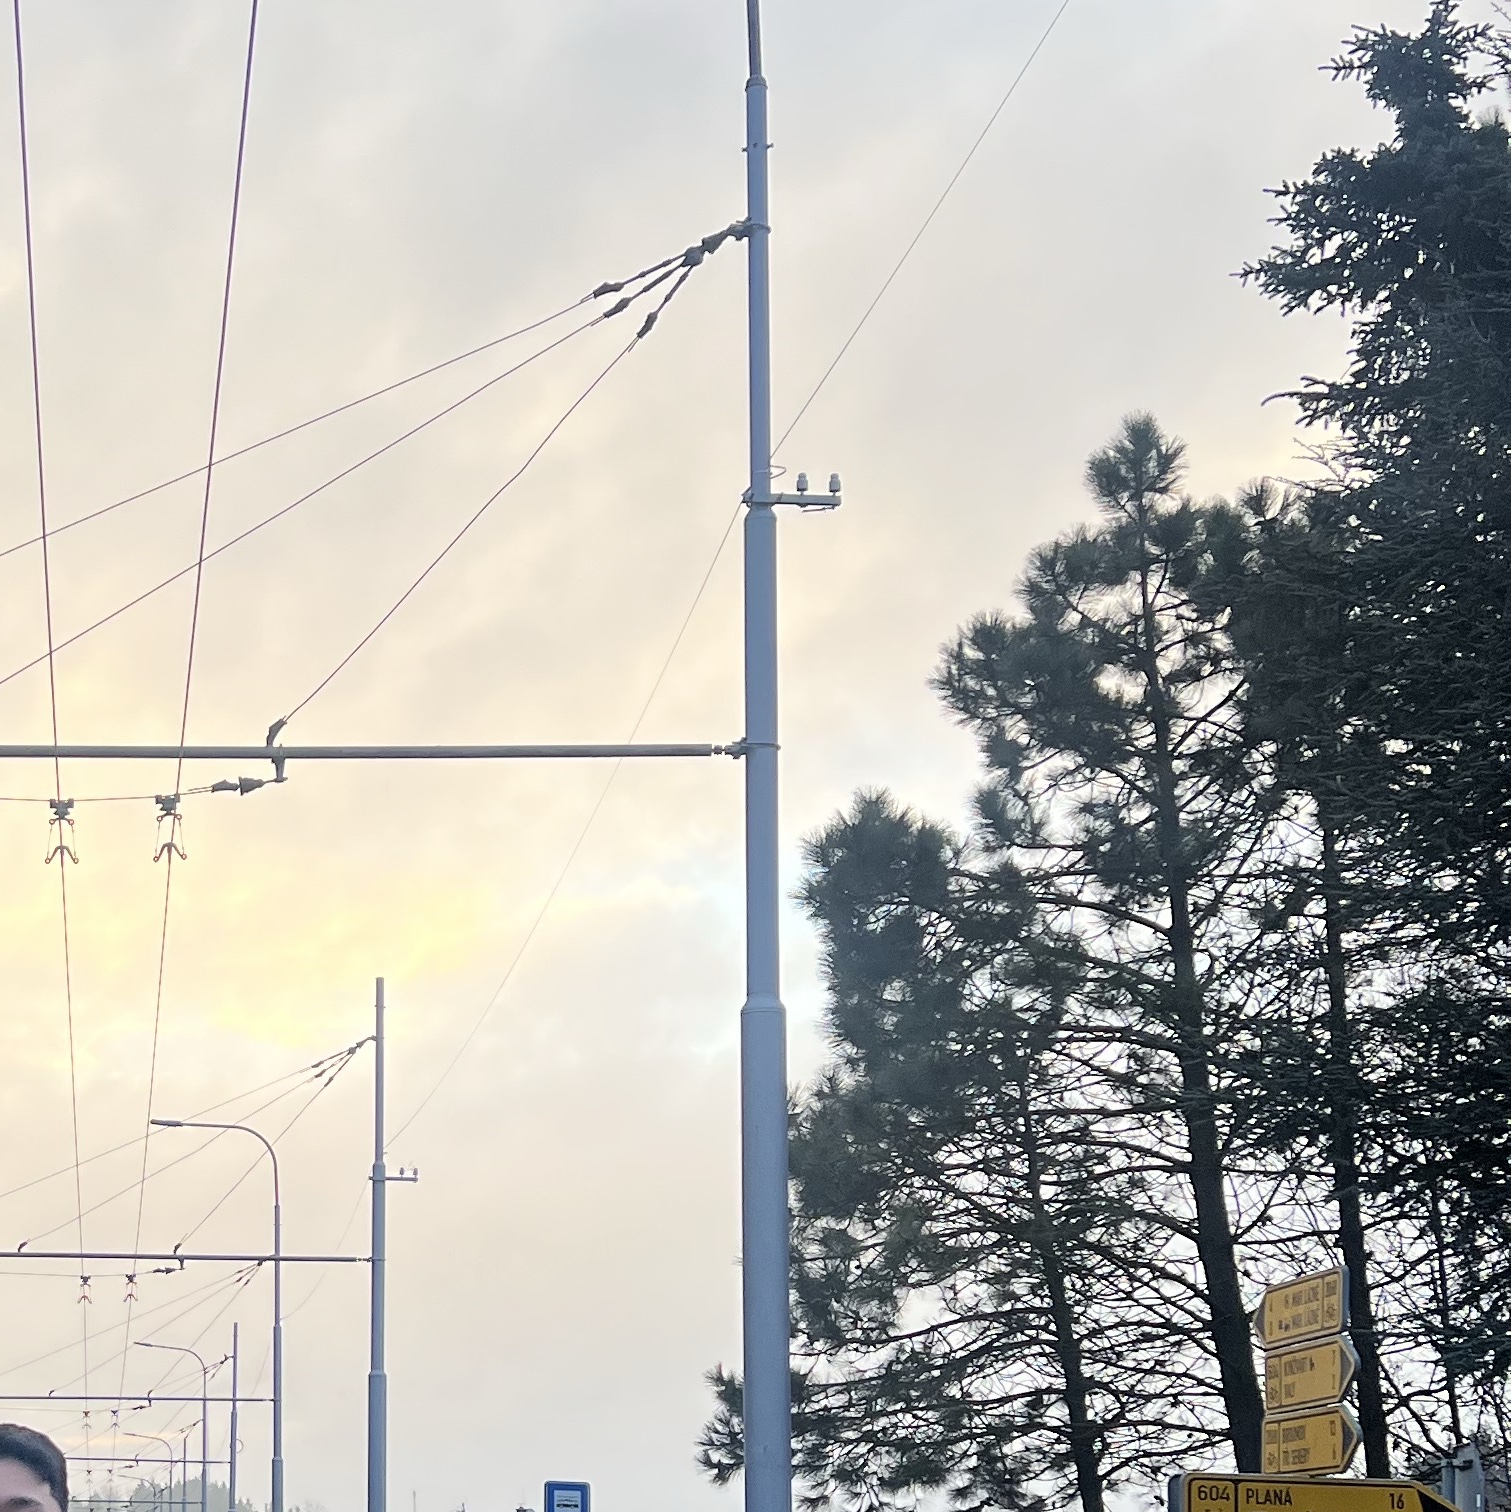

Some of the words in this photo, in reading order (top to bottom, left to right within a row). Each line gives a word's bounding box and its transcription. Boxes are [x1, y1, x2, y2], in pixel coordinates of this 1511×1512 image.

[1197, 1485, 1231, 1502] 604
[1245, 1486, 1293, 1506] PLANÁ
[1389, 1492, 1405, 1510] 16
